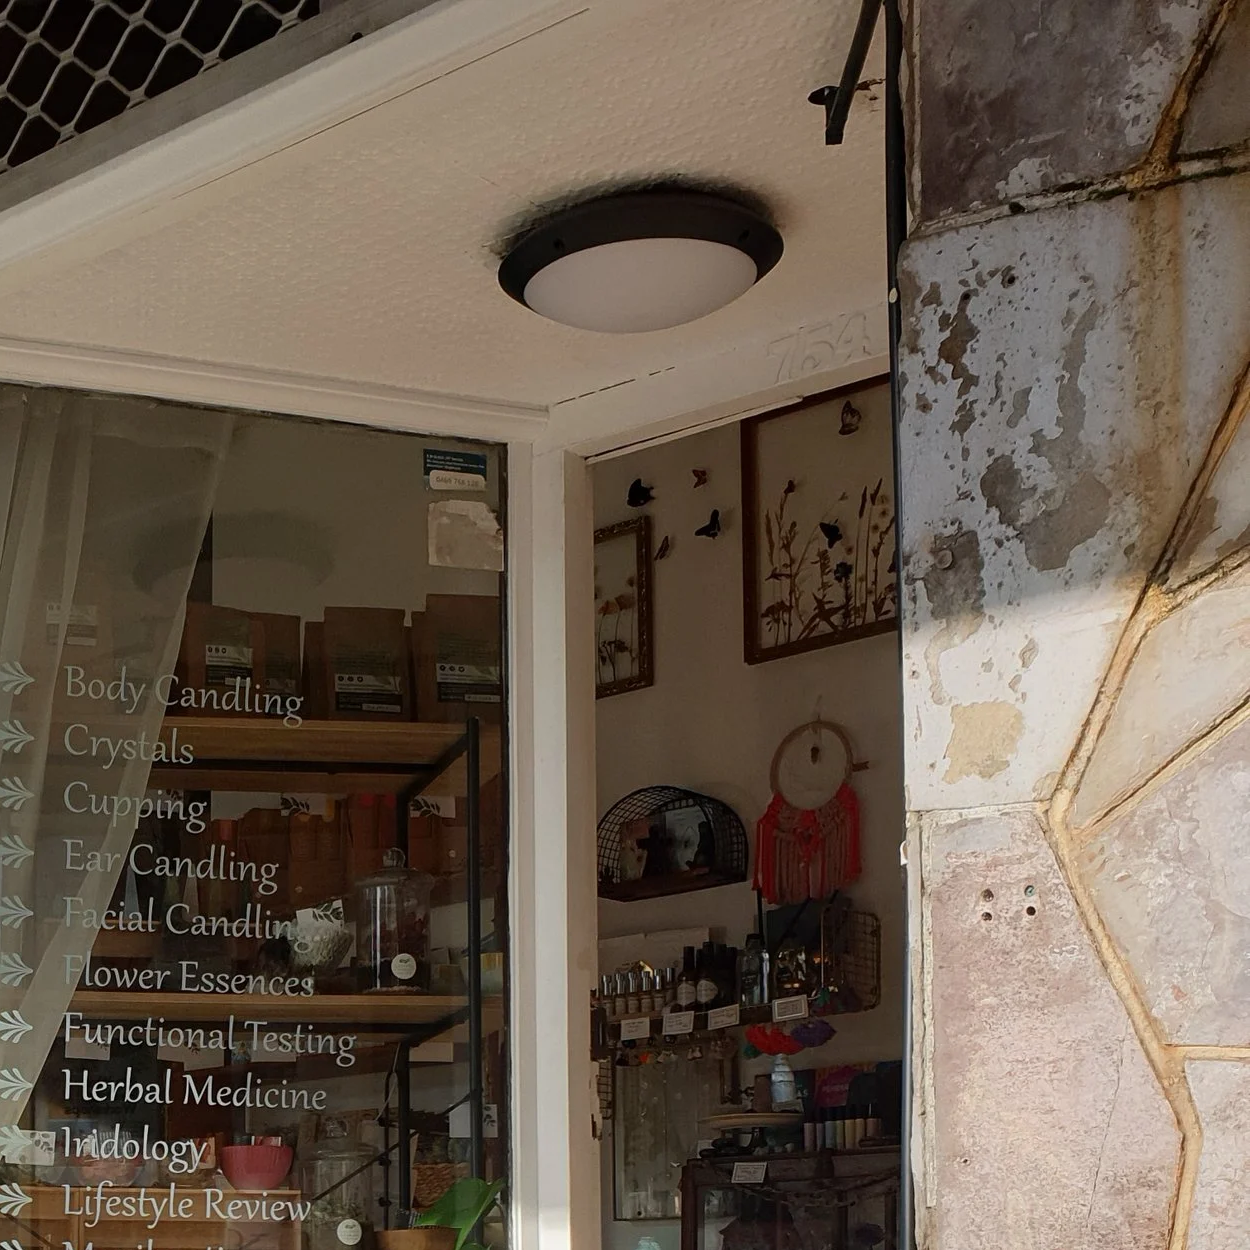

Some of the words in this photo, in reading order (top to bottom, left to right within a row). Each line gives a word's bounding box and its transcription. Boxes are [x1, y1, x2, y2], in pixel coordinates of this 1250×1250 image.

[64, 666, 146, 713] Body
[155, 675, 303, 727] Candling
[64, 724, 194, 769] Crystals
[64, 782, 207, 833] Cupping
[63, 839, 121, 873] Ear
[129, 844, 279, 894] Candling
[63, 896, 156, 932] Facial
[166, 902, 312, 953] Candling
[63, 954, 170, 990] Flower
[179, 961, 315, 997] Essences
[62, 1011, 235, 1050] Functional
[244, 1020, 357, 1067] Testing
[62, 1067, 172, 1105] Herbal
[183, 1072, 327, 1110] Medicine
[62, 1123, 208, 1174] Iridology
[62, 1181, 193, 1228] Lifestyle
[203, 1187, 311, 1222] Review
